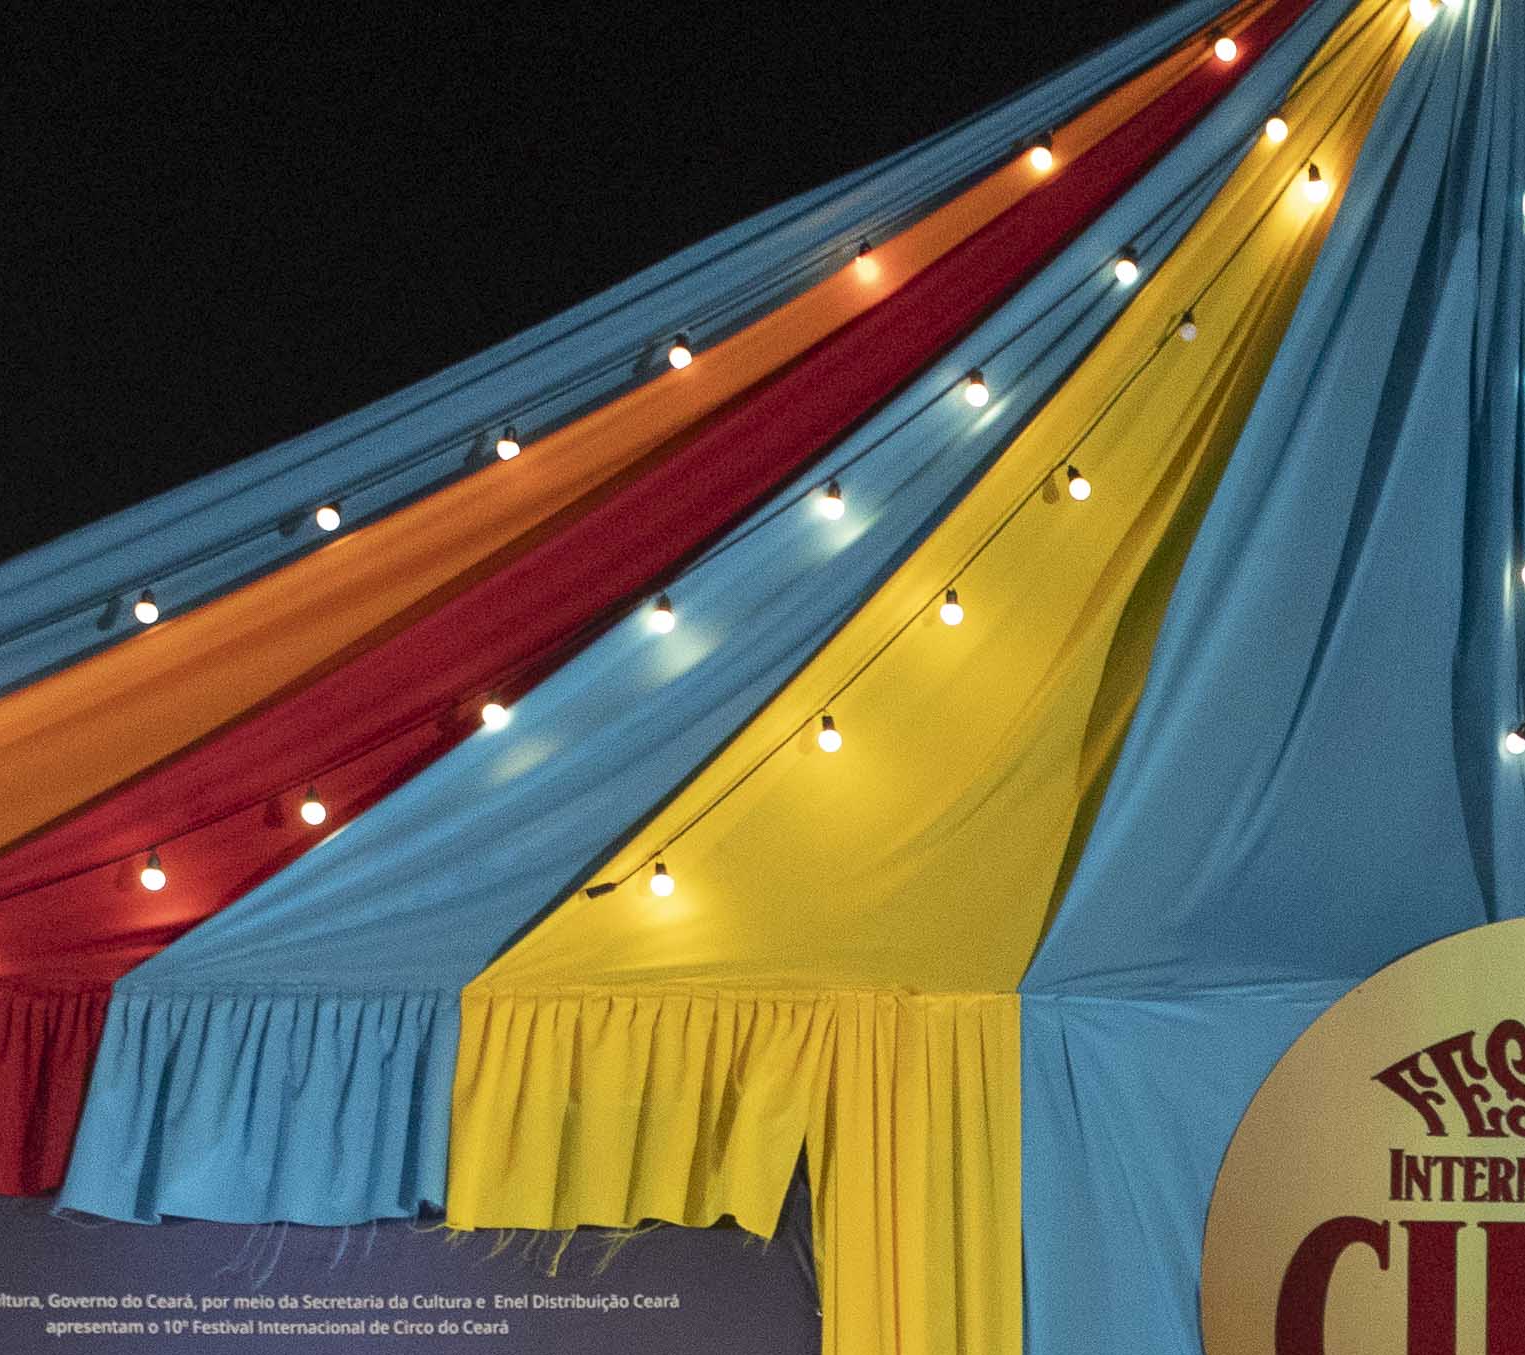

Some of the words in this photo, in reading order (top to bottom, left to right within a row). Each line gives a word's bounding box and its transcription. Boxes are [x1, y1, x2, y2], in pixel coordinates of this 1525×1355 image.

[48, 1294, 117, 1309] Governo
[122, 1294, 143, 1309] do
[147, 1293, 197, 1311] Ceará,
[202, 1297, 229, 1313] por
[234, 1294, 275, 1310] meio
[278, 1294, 298, 1310] da
[302, 1294, 383, 1310] Secretaria
[388, 1294, 408, 1310] da
[412, 1294, 472, 1310] Cultura
[475, 1298, 486, 1310] e
[494, 1294, 528, 1309] Enel
[533, 1293, 629, 1312] Distribuição
[633, 1293, 680, 1309] Ceará
[46, 1321, 144, 1337] apresentam
[149, 1323, 159, 1335] o
[193, 1320, 254, 1335] Festival
[258, 1320, 365, 1335] Internacional
[369, 1320, 390, 1335] de
[394, 1320, 434, 1335] Circo
[438, 1320, 459, 1335] do
[463, 1320, 509, 1335] Ceará
